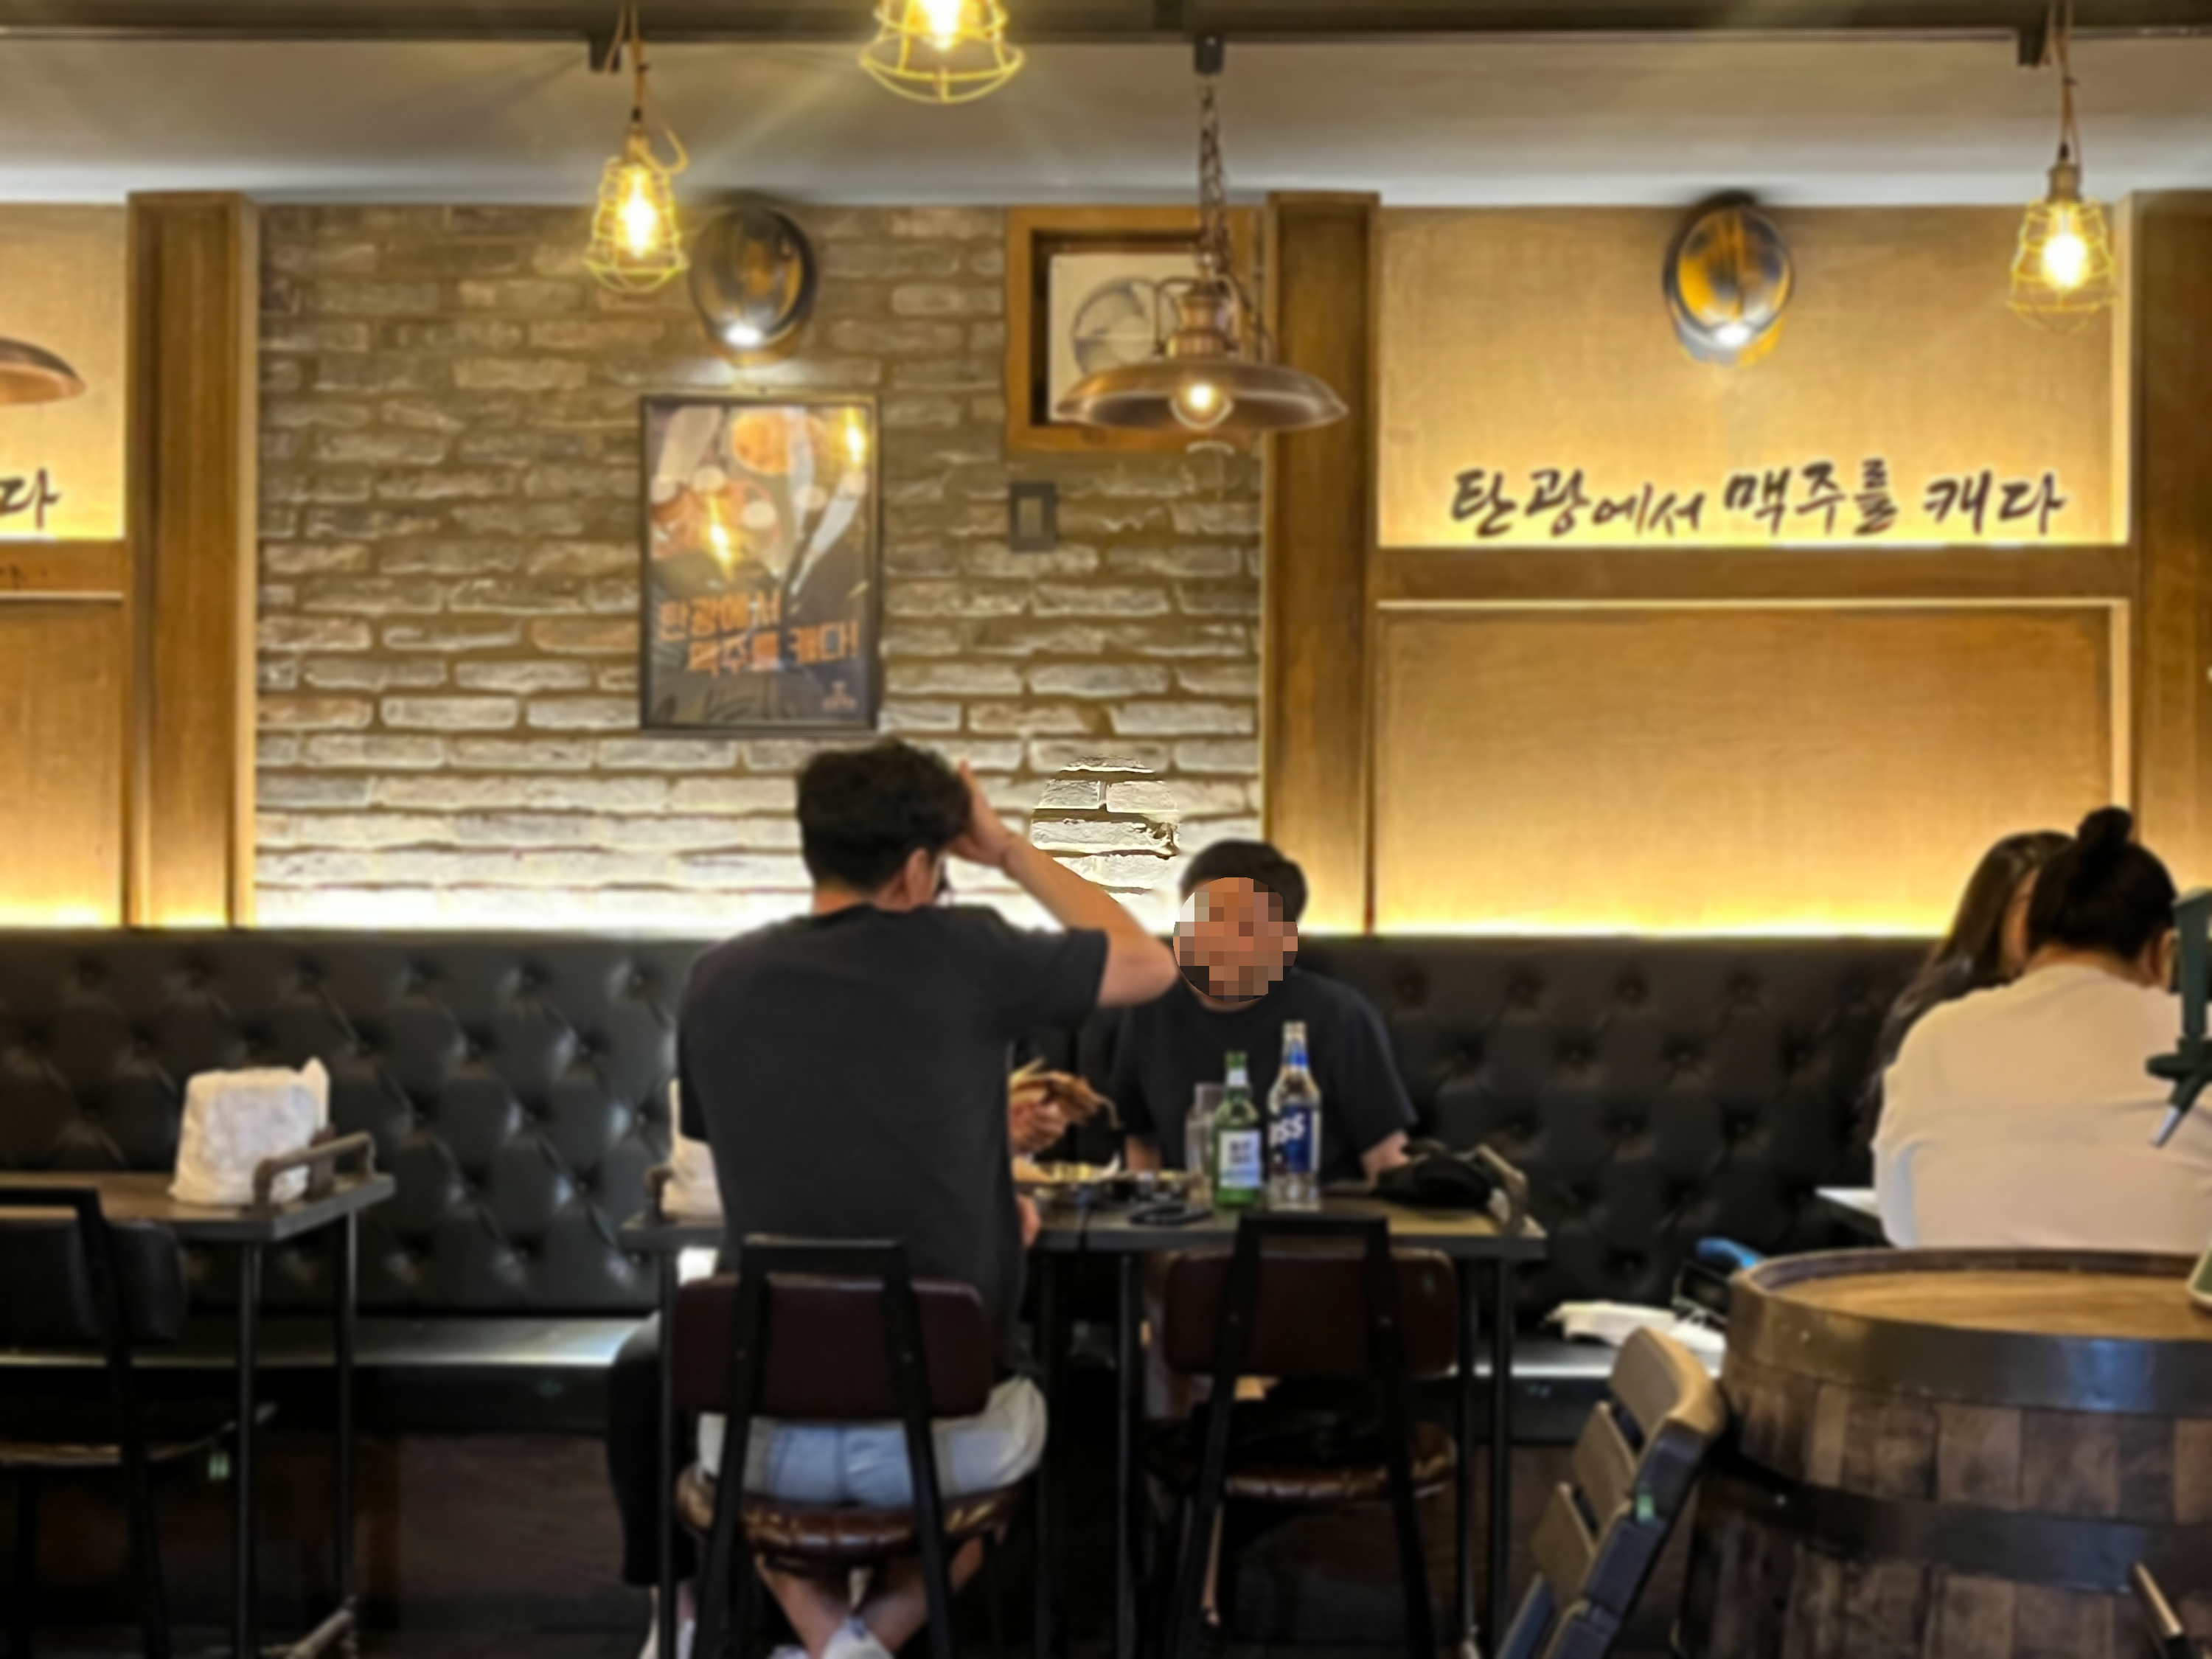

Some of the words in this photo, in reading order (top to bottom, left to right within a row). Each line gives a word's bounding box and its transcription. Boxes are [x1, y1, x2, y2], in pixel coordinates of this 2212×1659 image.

[0, 468, 60, 530] 다
[1450, 467, 1705, 537] 탄광에서
[1722, 457, 1899, 535] 맥주를
[1922, 470, 2067, 535] 캐다
